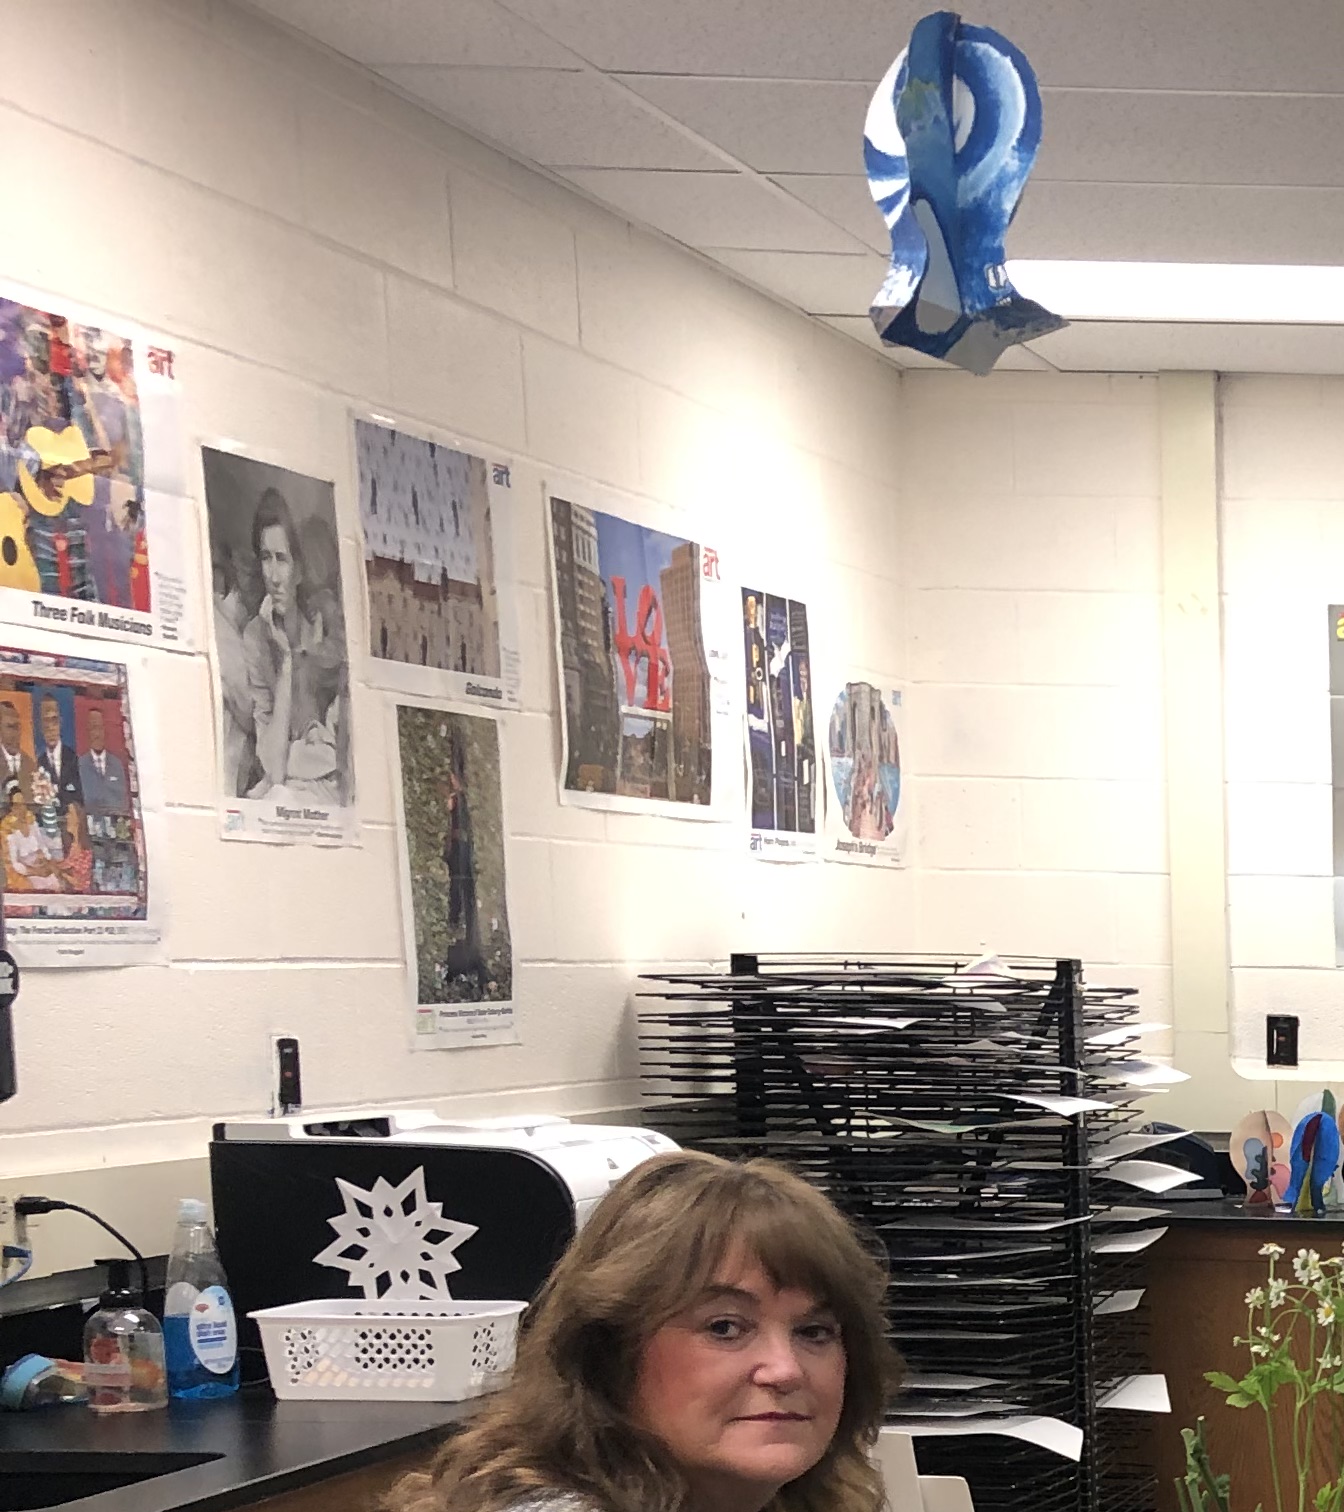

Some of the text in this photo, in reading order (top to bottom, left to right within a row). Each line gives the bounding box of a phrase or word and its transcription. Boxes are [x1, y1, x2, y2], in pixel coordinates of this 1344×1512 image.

[148, 349, 175, 380] art
[492, 466, 511, 488] art
[703, 550, 721, 580] art
[31, 600, 68, 622] Three
[70, 606, 96, 627] Folk
[98, 611, 153, 636] Musicians
[303, 808, 329, 821] Mother
[750, 834, 763, 851] art
